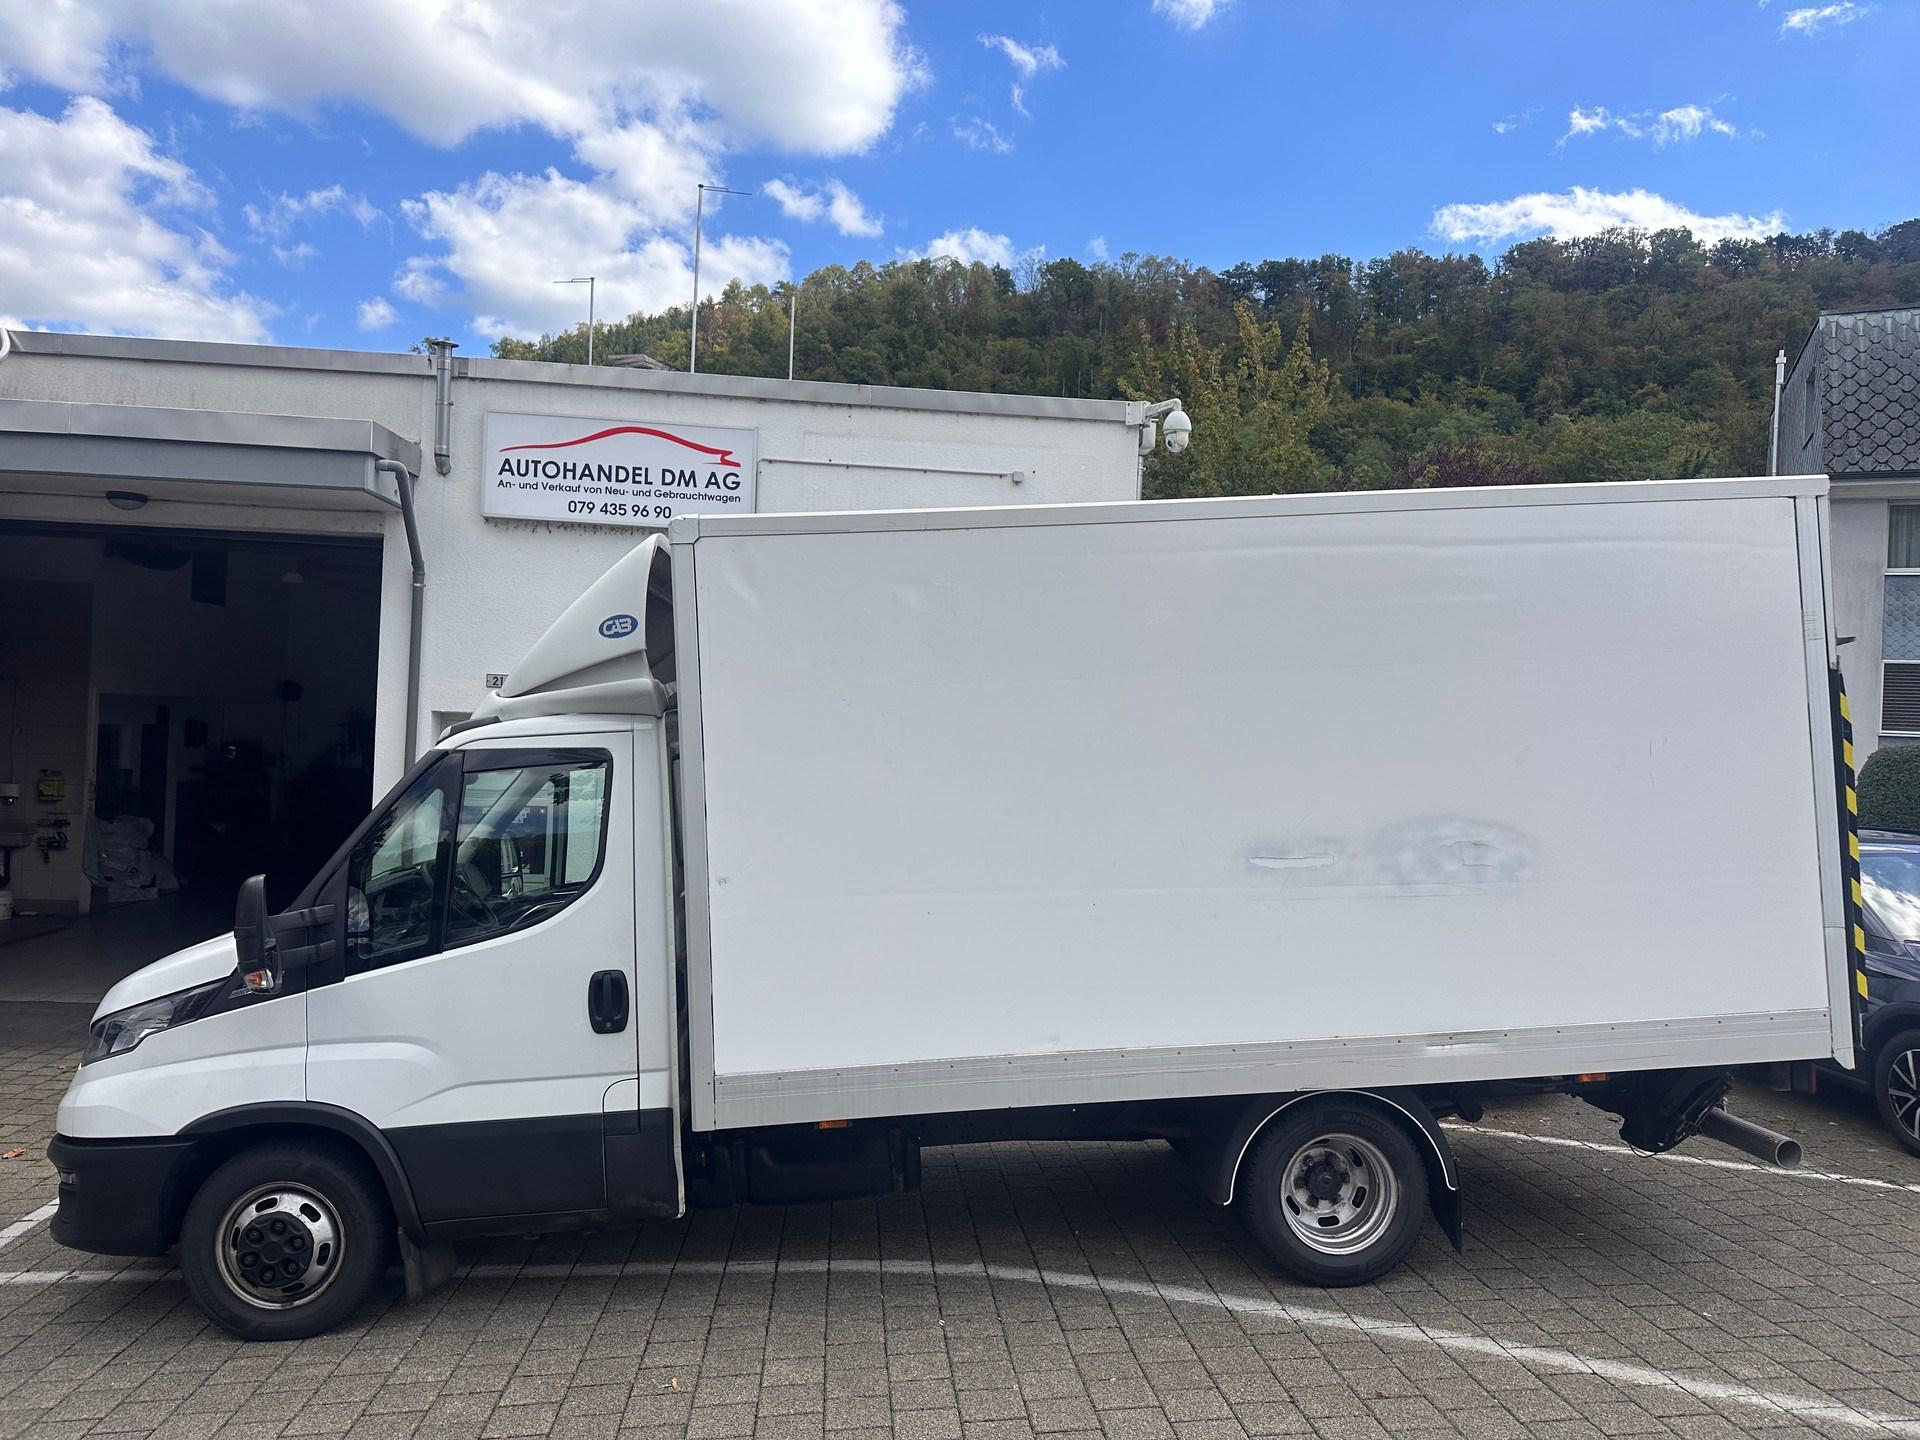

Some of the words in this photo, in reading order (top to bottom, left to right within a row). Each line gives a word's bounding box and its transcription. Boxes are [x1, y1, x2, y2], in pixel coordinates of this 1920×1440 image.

[498, 458, 653, 485] AUTOHANDEL
[661, 468, 697, 488] DM
[705, 471, 741, 490] AG
[497, 479, 516, 488] An-
[519, 481, 538, 490] und
[541, 482, 581, 492] Verkauf
[583, 486, 602, 494] von
[605, 486, 629, 496] Neu-
[632, 489, 651, 497] und
[654, 489, 741, 504] Gebrauchtwagen
[567, 500, 595, 514] 079
[599, 502, 627, 516] 435
[631, 504, 650, 518] 96
[653, 505, 672, 519] 90
[602, 617, 632, 635] CAB
[492, 676, 504, 686] 21
